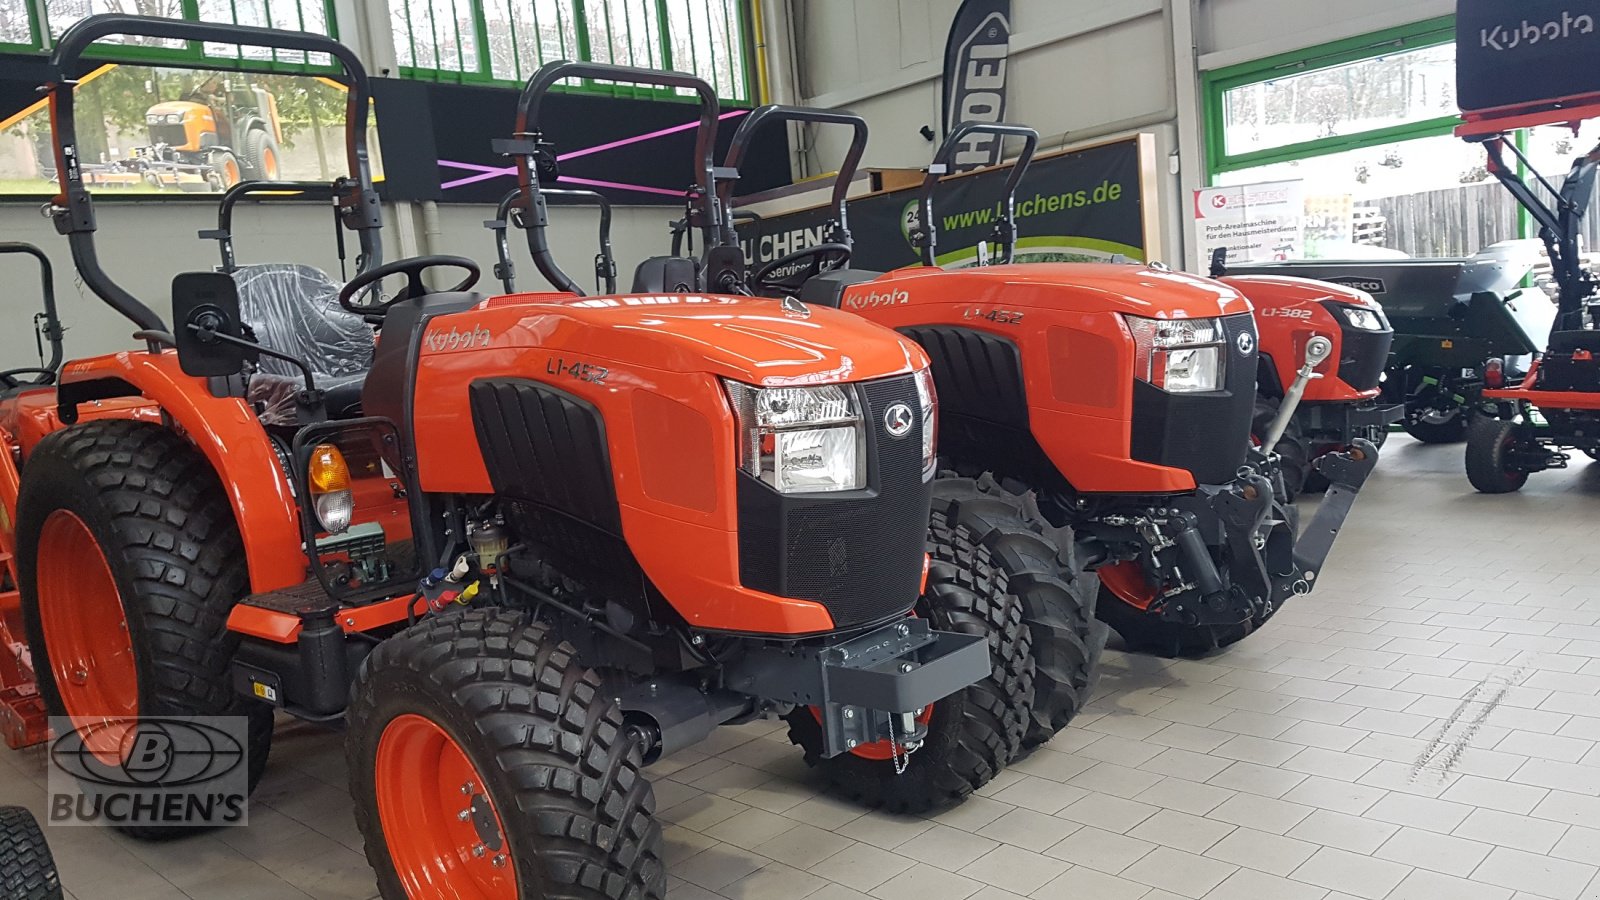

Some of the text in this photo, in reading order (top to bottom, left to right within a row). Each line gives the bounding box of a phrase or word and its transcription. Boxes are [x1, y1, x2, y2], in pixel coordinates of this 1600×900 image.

[1481, 11, 1593, 50] Kubota
[1206, 219, 1277, 232] Profi-Arealmaschine
[1206, 225, 1297, 240] für den Hausmeisterdienst
[846, 287, 909, 310] Kubota
[1261, 307, 1313, 319] L1-382
[424, 323, 491, 352] Kubota
[546, 357, 609, 385] L1-452
